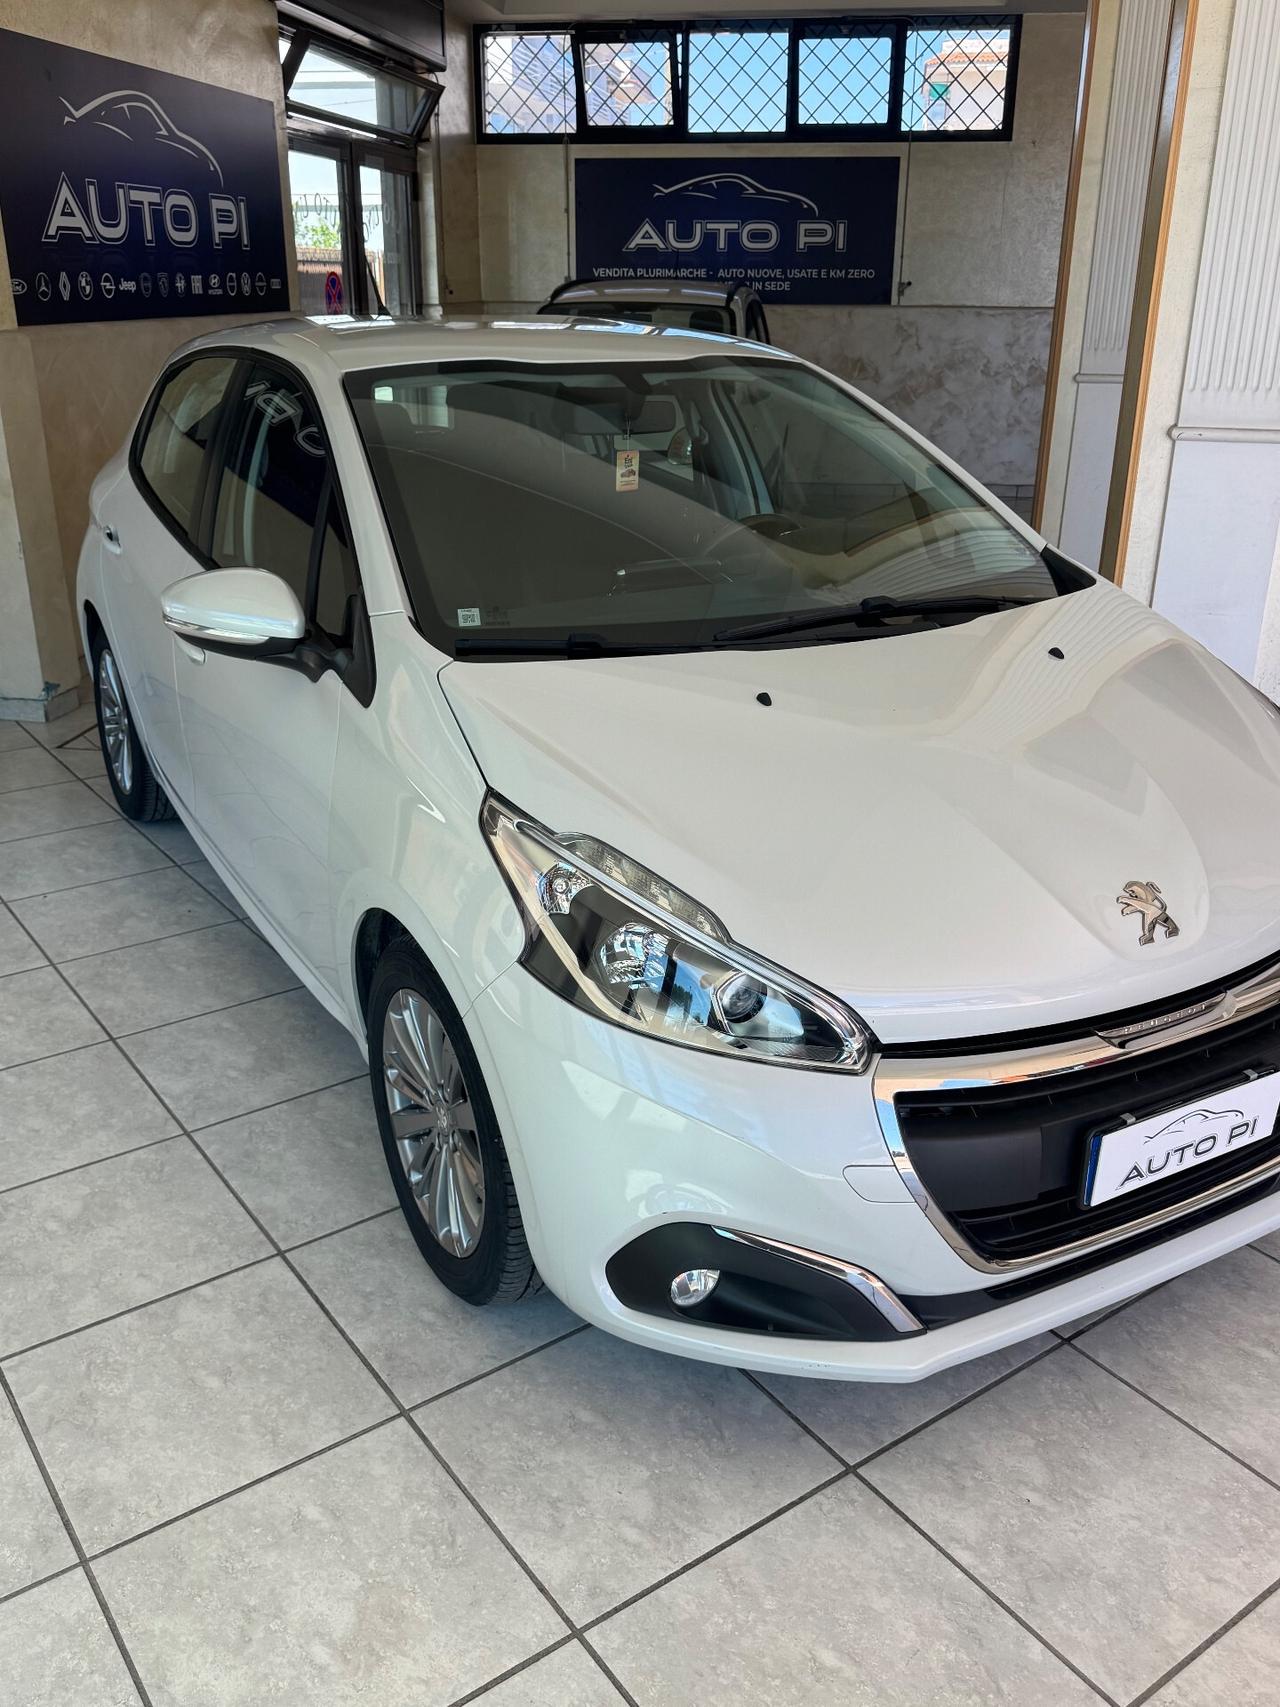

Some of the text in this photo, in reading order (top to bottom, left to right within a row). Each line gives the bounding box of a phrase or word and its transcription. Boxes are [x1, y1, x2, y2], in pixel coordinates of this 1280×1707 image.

[42, 171, 199, 248] AUTO
[208, 193, 250, 250] PI
[622, 218, 847, 252] AUTO PI
[119, 278, 137, 292] Jeep
[592, 267, 634, 278] VENDITA
[718, 268, 745, 278] AUTO
[747, 268, 785, 279] NUOVE,
[787, 269, 819, 279] USATE
[821, 269, 828, 278] E
[830, 269, 846, 279] KM
[848, 269, 876, 279] ZERO
[752, 281, 763, 291] IN
[765, 281, 791, 291] SEDE
[1115, 1115, 1260, 1191] AUTO PI
